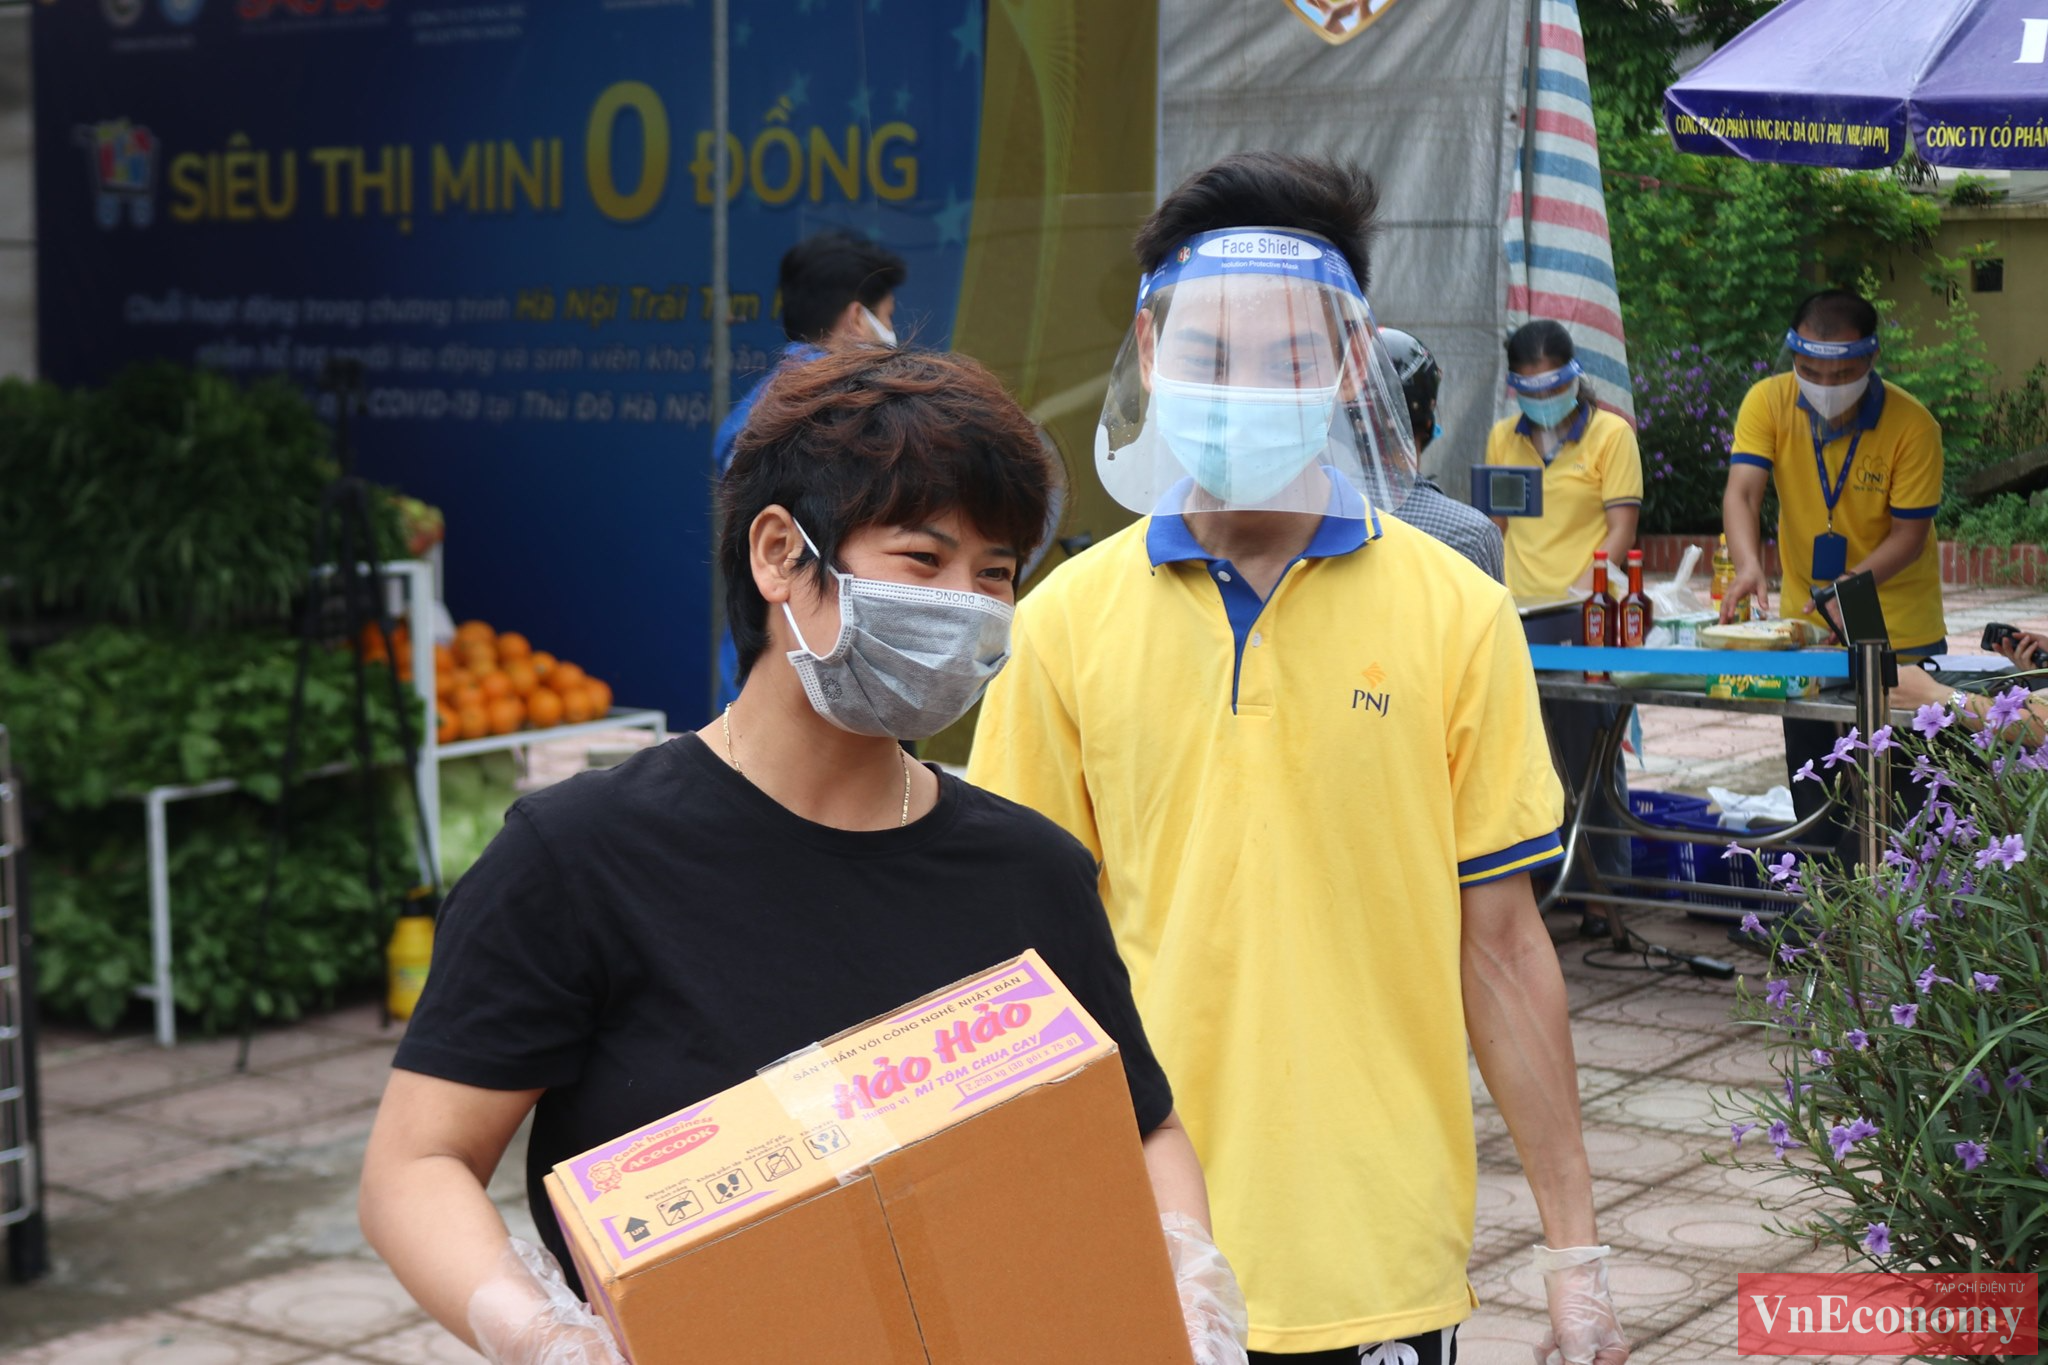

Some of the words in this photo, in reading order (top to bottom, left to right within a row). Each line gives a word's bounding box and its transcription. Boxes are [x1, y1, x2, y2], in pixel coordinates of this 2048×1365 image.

[1751, 116, 1773, 140] VÀNG
[1775, 120, 1792, 145] BẠC
[1793, 116, 1806, 142] ĐÁ
[1807, 116, 1825, 144] QUÝ
[1827, 117, 1845, 145] PHÚ
[1926, 120, 1966, 148] CÔNG
[1970, 126, 1987, 147] TY
[1990, 114, 2012, 148] CỔ
[168, 130, 299, 223] SIÊU
[309, 145, 414, 235] THỊ
[431, 136, 563, 214] MINI
[585, 80, 669, 222] 0
[689, 96, 918, 206] ĐỒNG
[1222, 239, 1254, 255] Face
[1258, 238, 1299, 256] Shield
[515, 286, 556, 321] Hà
[563, 284, 618, 329] Nội
[629, 284, 688, 321] Trái
[698, 287, 760, 321] Tm
[368, 388, 482, 421] COVID-19
[522, 389, 569, 421] Thủ
[619, 392, 658, 421] Hà
[1352, 688, 1391, 718] PNJ
[822, 1049, 857, 1067] PHẨM
[883, 1022, 919, 1040] CÔNG
[921, 1005, 956, 1024] NGHỆ
[958, 990, 990, 1007] NHẬT
[994, 977, 1020, 992] BẢN
[832, 1056, 932, 1120] Hảo
[933, 1003, 1032, 1063] Hảo
[1050, 1041, 1064, 1053] 75
[915, 1080, 933, 1097] MÌ
[936, 1066, 969, 1085] TÔM
[972, 1049, 1009, 1070] CHUA
[1012, 1035, 1041, 1055] CAY
[614, 1141, 646, 1162] Cook
[646, 1116, 714, 1142] happiness
[632, 1226, 645, 1238] UP
